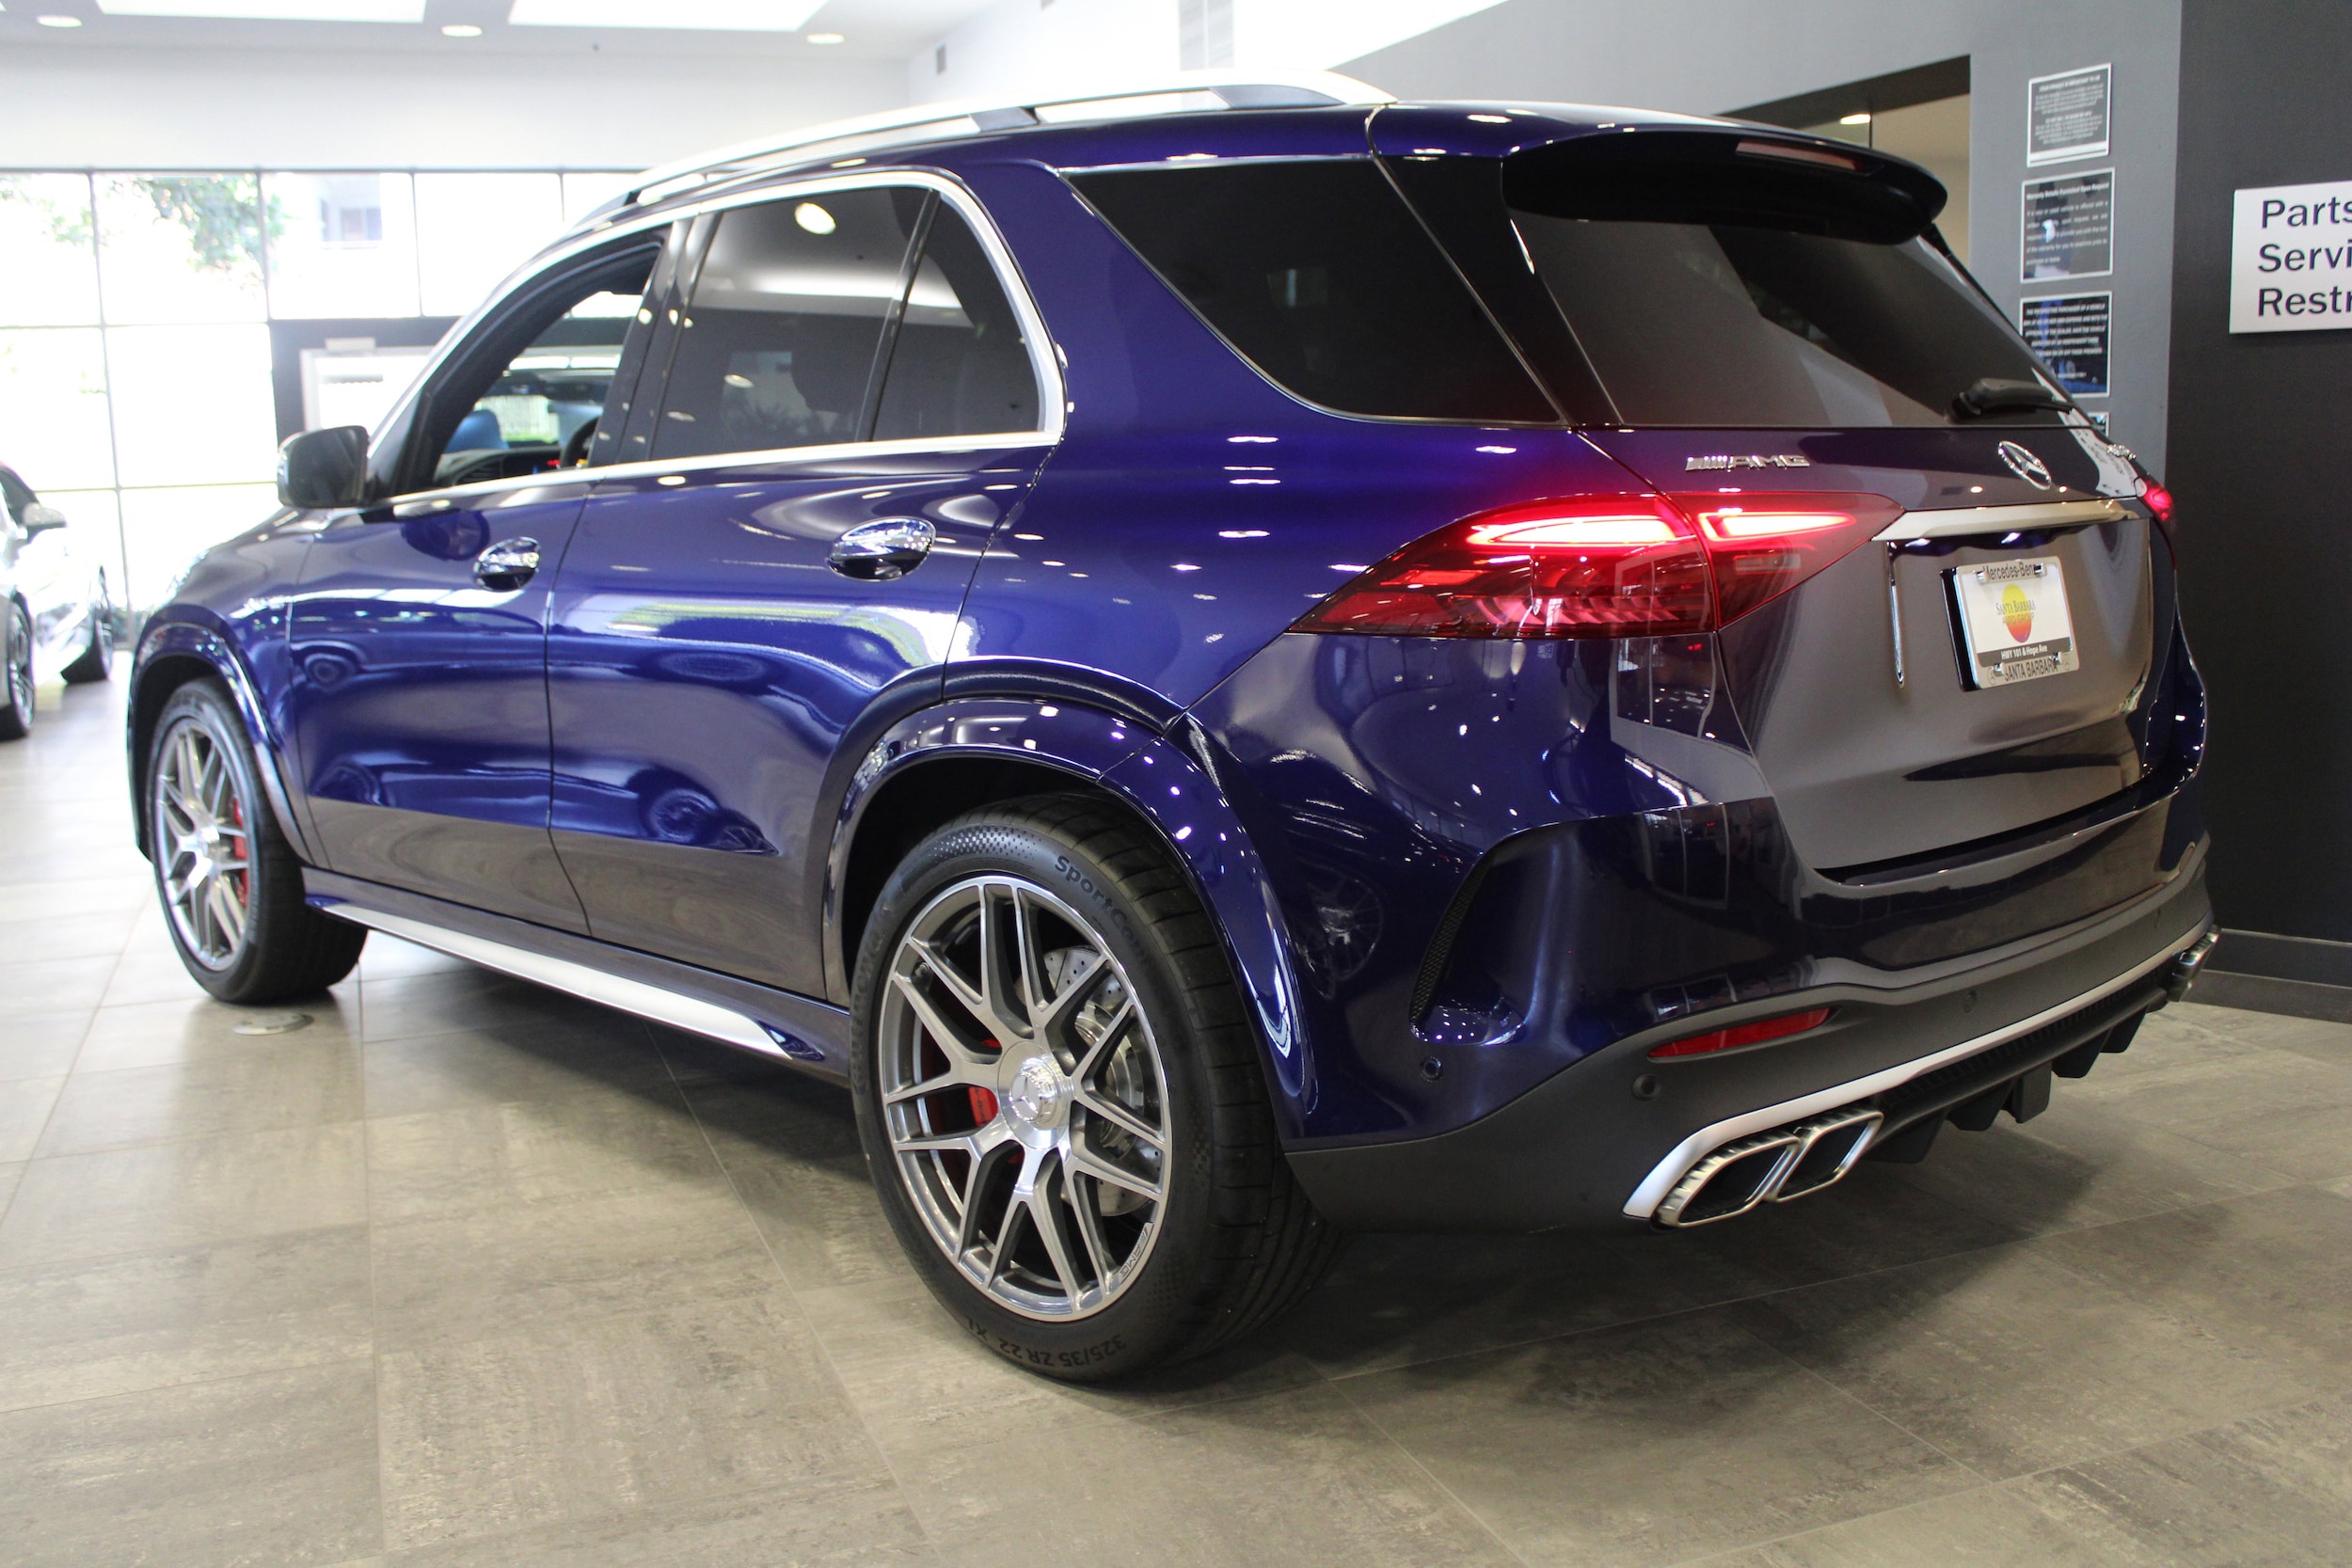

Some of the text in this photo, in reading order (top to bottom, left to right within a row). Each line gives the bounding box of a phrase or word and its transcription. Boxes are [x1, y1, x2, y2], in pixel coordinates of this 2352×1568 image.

[2257, 238, 2352, 273] Servi
[1727, 454, 1810, 472] AMG
[1982, 562, 2033, 580] Mercedes-Ben
[2001, 650, 2013, 660] HWY
[2013, 648, 2022, 658] 101
[2026, 645, 2039, 657] Hope
[997, 1337, 1023, 1360] 22
[1025, 1347, 1055, 1367] ZR
[1057, 1333, 1128, 1368] 325/35
